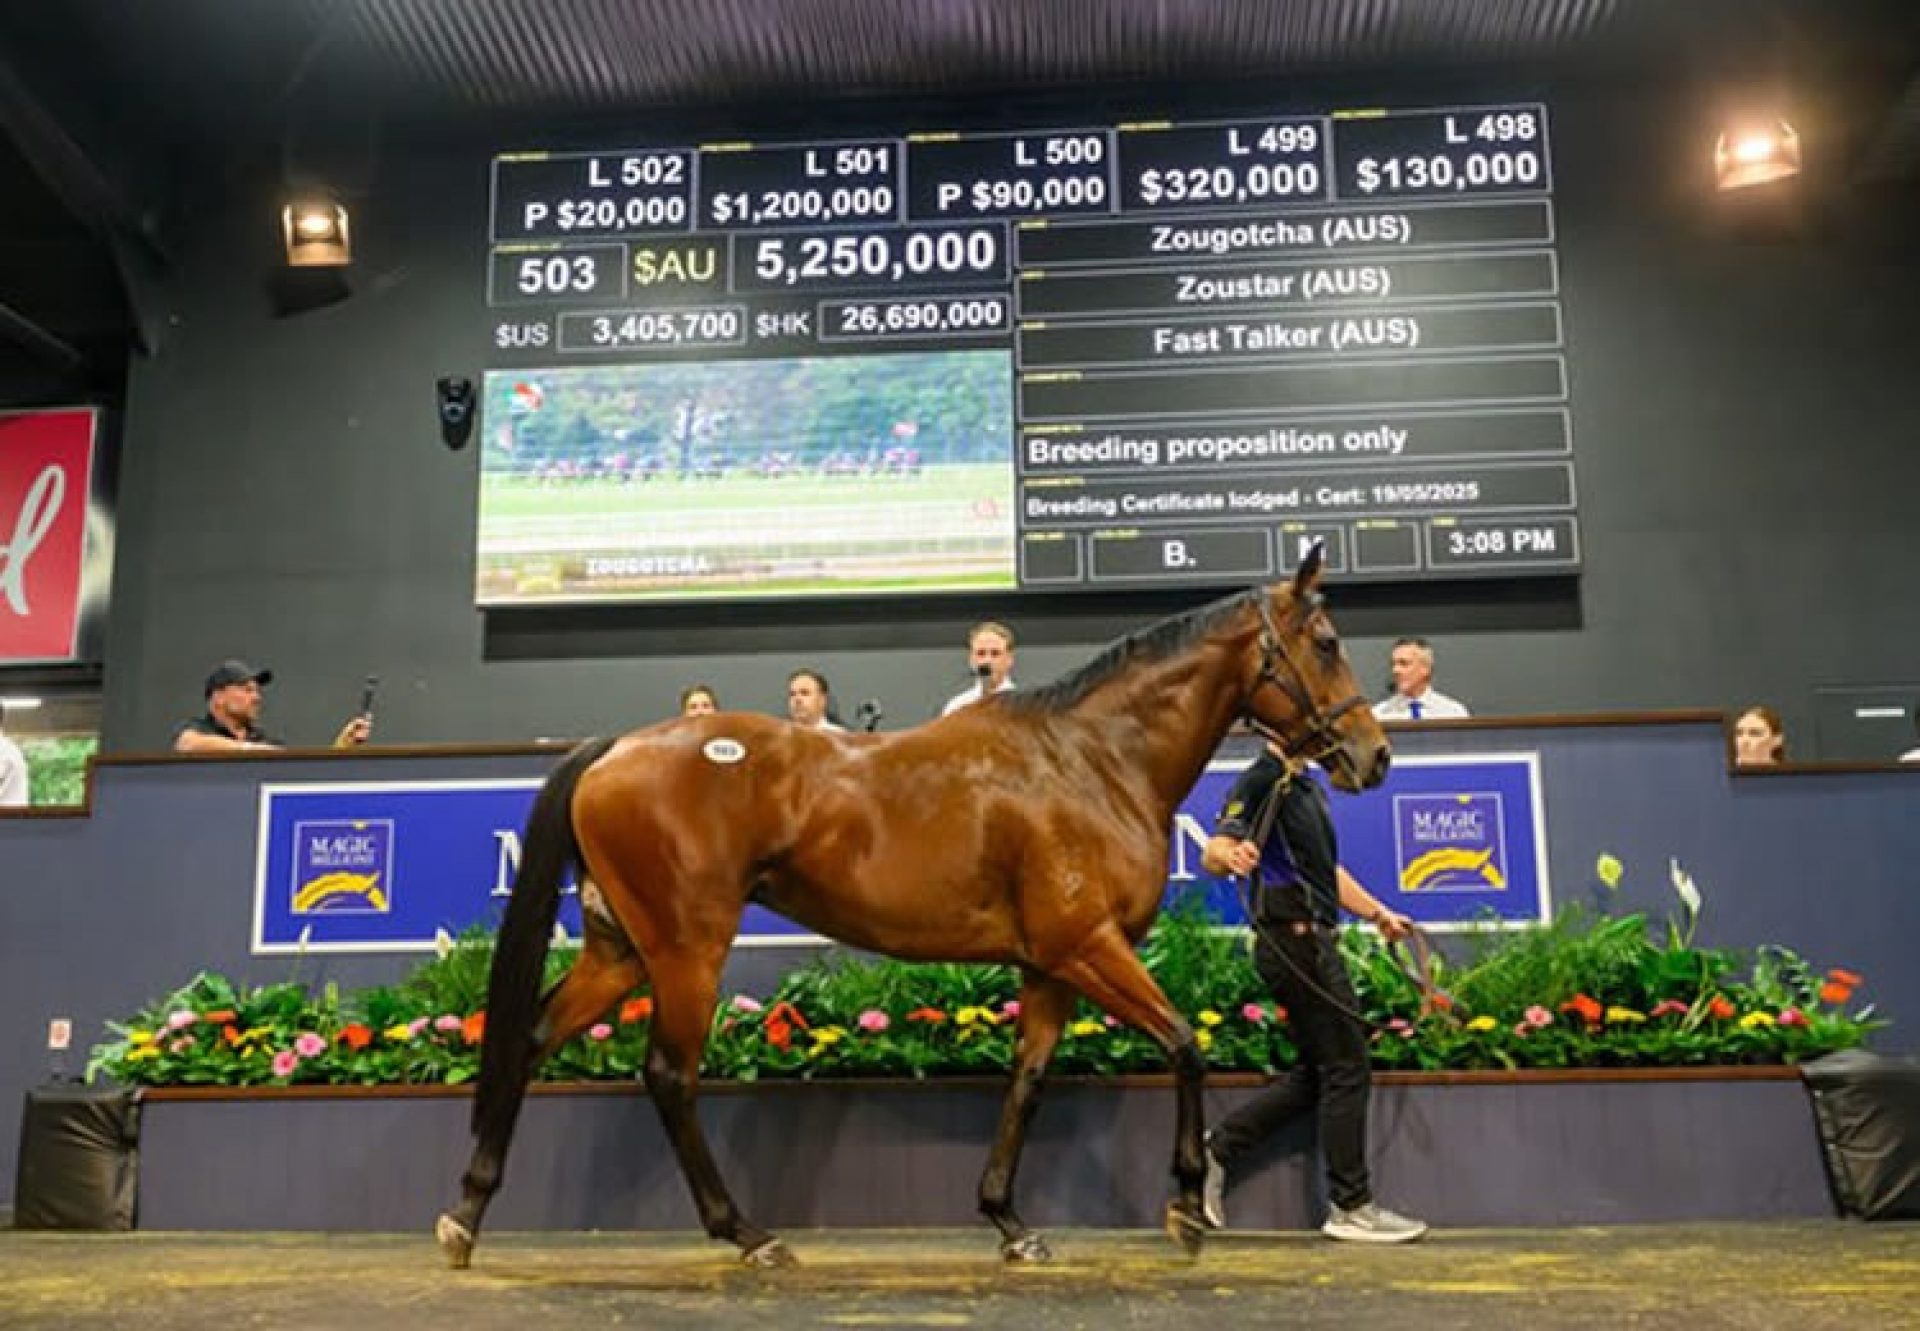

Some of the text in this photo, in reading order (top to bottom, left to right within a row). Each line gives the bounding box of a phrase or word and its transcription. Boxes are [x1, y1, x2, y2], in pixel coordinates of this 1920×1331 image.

[1228, 124, 1317, 155] L 499
[1445, 112, 1537, 144] L 498
[806, 148, 888, 176] L 501
[1015, 136, 1102, 166] L 500
[589, 155, 683, 187] L 502
[1139, 161, 1319, 205] $320,000
[1356, 151, 1539, 193] $130,000
[712, 186, 892, 225] $1,200,000
[937, 176, 1105, 212] P $90,000
[524, 196, 686, 231] P $20,000
[1151, 214, 1411, 254] Zougotcha (AUS)
[518, 256, 596, 293] 503
[633, 248, 716, 285] $AU
[756, 231, 996, 285] 5,250,000
[1176, 266, 1391, 301] Zoustar (AUS)
[593, 311, 738, 349] 3,405,700
[756, 310, 811, 338] $HK
[841, 301, 1002, 333] 26,690,000
[495, 322, 549, 348] $US
[1154, 317, 1420, 354] Fast Talker (AUS)
[1028, 425, 1408, 464] Breeding proposition only
[1163, 540, 1197, 567] B.
[1449, 529, 1555, 555] 3:08 PM
